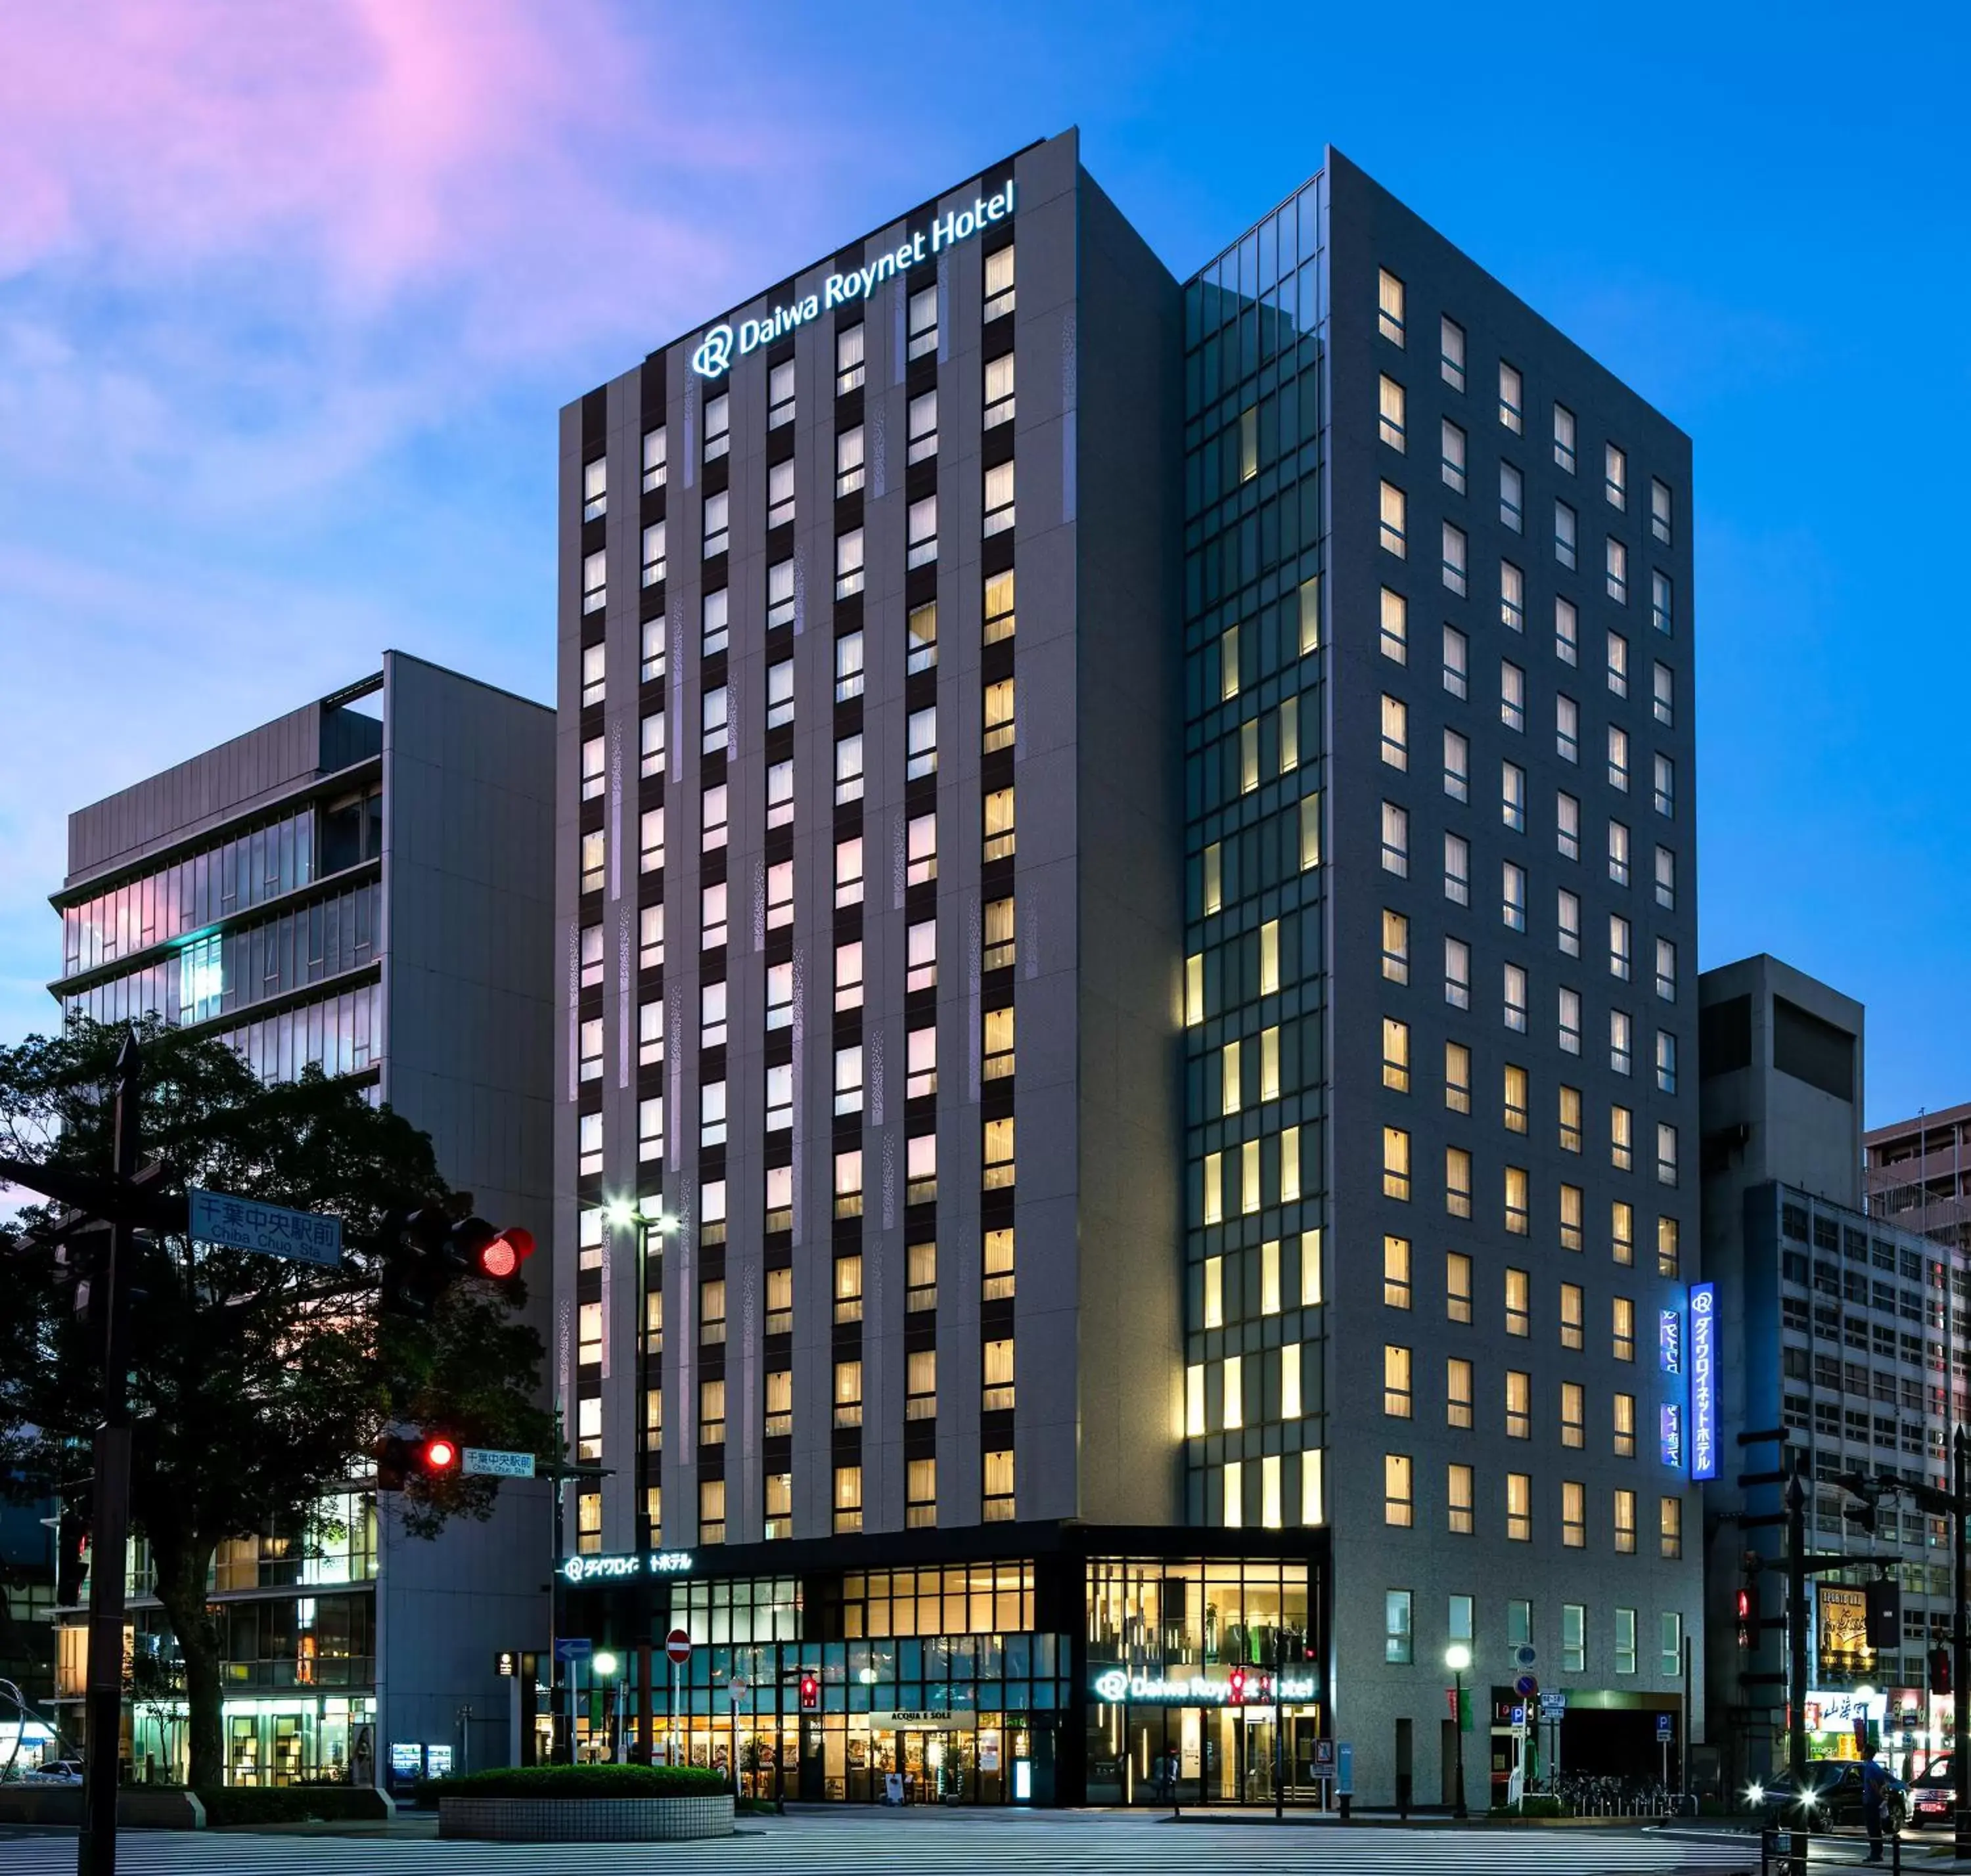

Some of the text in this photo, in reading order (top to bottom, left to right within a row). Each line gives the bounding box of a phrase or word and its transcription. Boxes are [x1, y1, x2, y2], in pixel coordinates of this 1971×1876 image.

[739, 294, 819, 355] Daiwa
[824, 232, 926, 309] Roynet
[932, 178, 1015, 254] Hotel
[199, 1197, 334, 1247] 千葉中央駅前
[210, 1224, 321, 1258] Chiba Chuo Sta
[1694, 1316, 1713, 1472] ダイワロイネットホテル
[466, 1450, 532, 1468] 千葉中央駅前
[1131, 1677, 1189, 1697] Daiwa
[891, 1712, 920, 1722] ACQUA
[930, 1711, 952, 1720] SOLE
[1514, 1708, 1522, 1720] P
[1660, 1716, 1667, 1728] P
